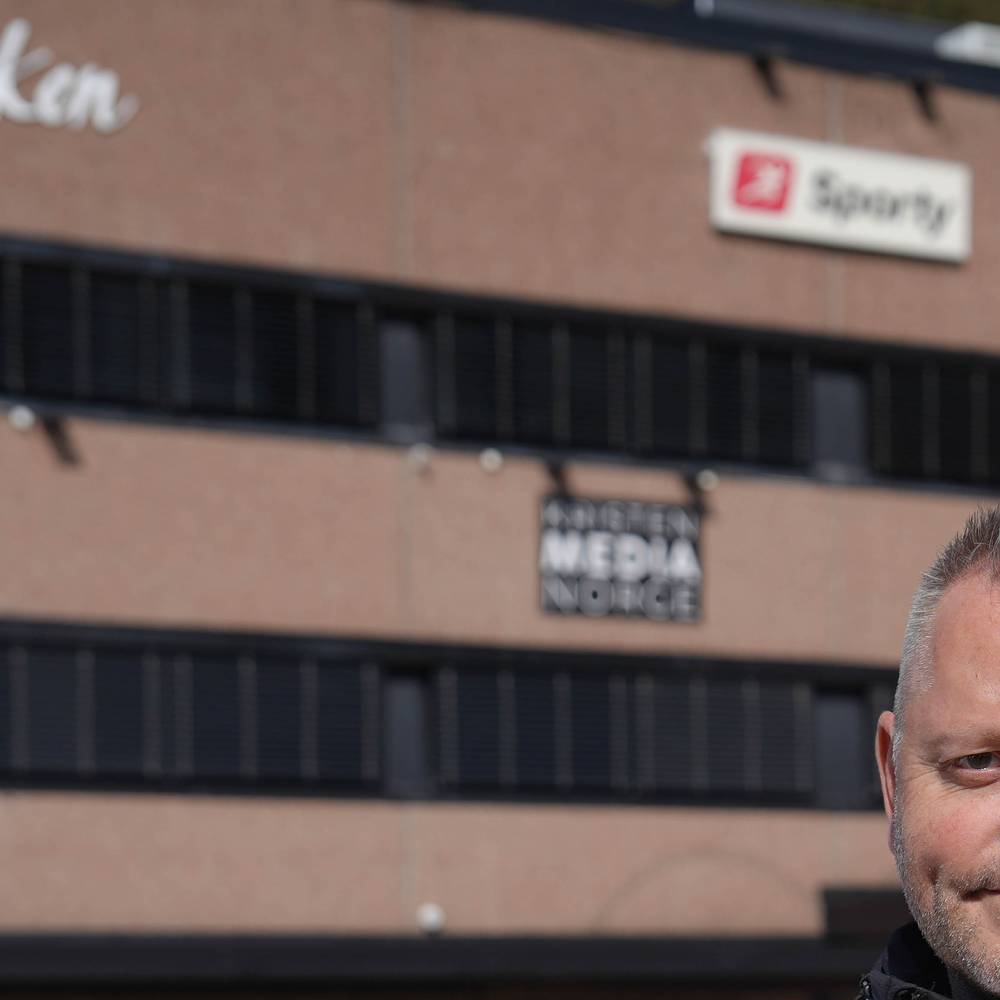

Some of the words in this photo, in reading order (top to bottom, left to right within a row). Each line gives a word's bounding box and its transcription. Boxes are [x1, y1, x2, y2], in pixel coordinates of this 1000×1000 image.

[809, 168, 951, 238] Sporty
[540, 529, 702, 581] MEDIA
[542, 575, 701, 620] NORGE
